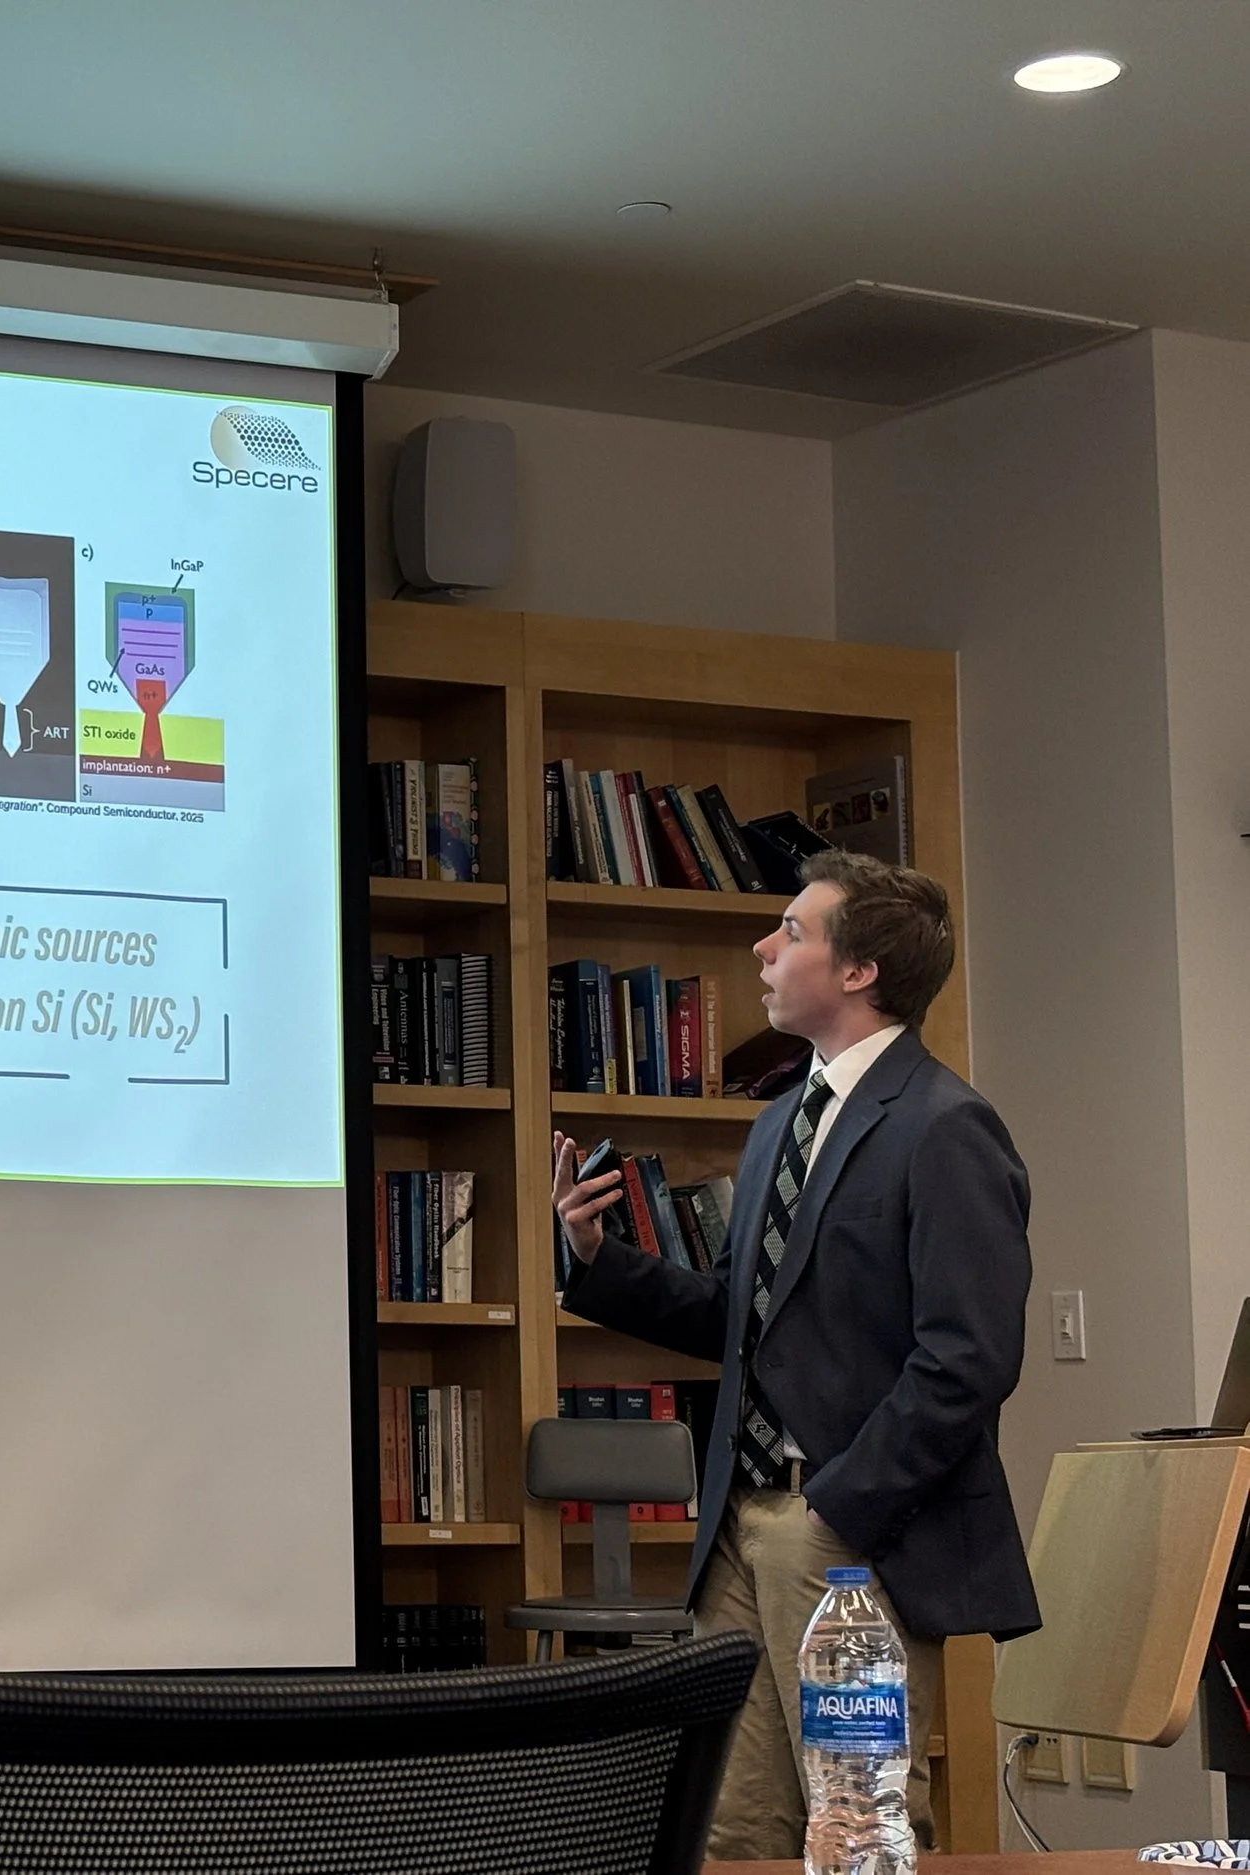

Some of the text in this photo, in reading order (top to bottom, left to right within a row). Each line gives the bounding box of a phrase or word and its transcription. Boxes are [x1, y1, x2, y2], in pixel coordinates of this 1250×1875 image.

[192, 462, 318, 493] Specere
[81, 544, 94, 562] c)
[170, 558, 204, 573] InGaP
[135, 663, 165, 676] GaAs
[87, 679, 118, 694] QWs
[44, 726, 69, 740] ART
[83, 725, 136, 741] STI oxide
[81, 759, 171, 776] implantation: n+
[82, 784, 92, 797] Si
[46, 803, 101, 817] Compound
[180, 811, 204, 823] 2025
[34, 926, 158, 967] sources
[32, 989, 65, 1034] Si
[70, 989, 118, 1042] (Si,
[399, 990, 410, 1045] Antennas
[681, 1024, 691, 1081] SIGMA
[816, 1696, 901, 1720] AQUAFINA
